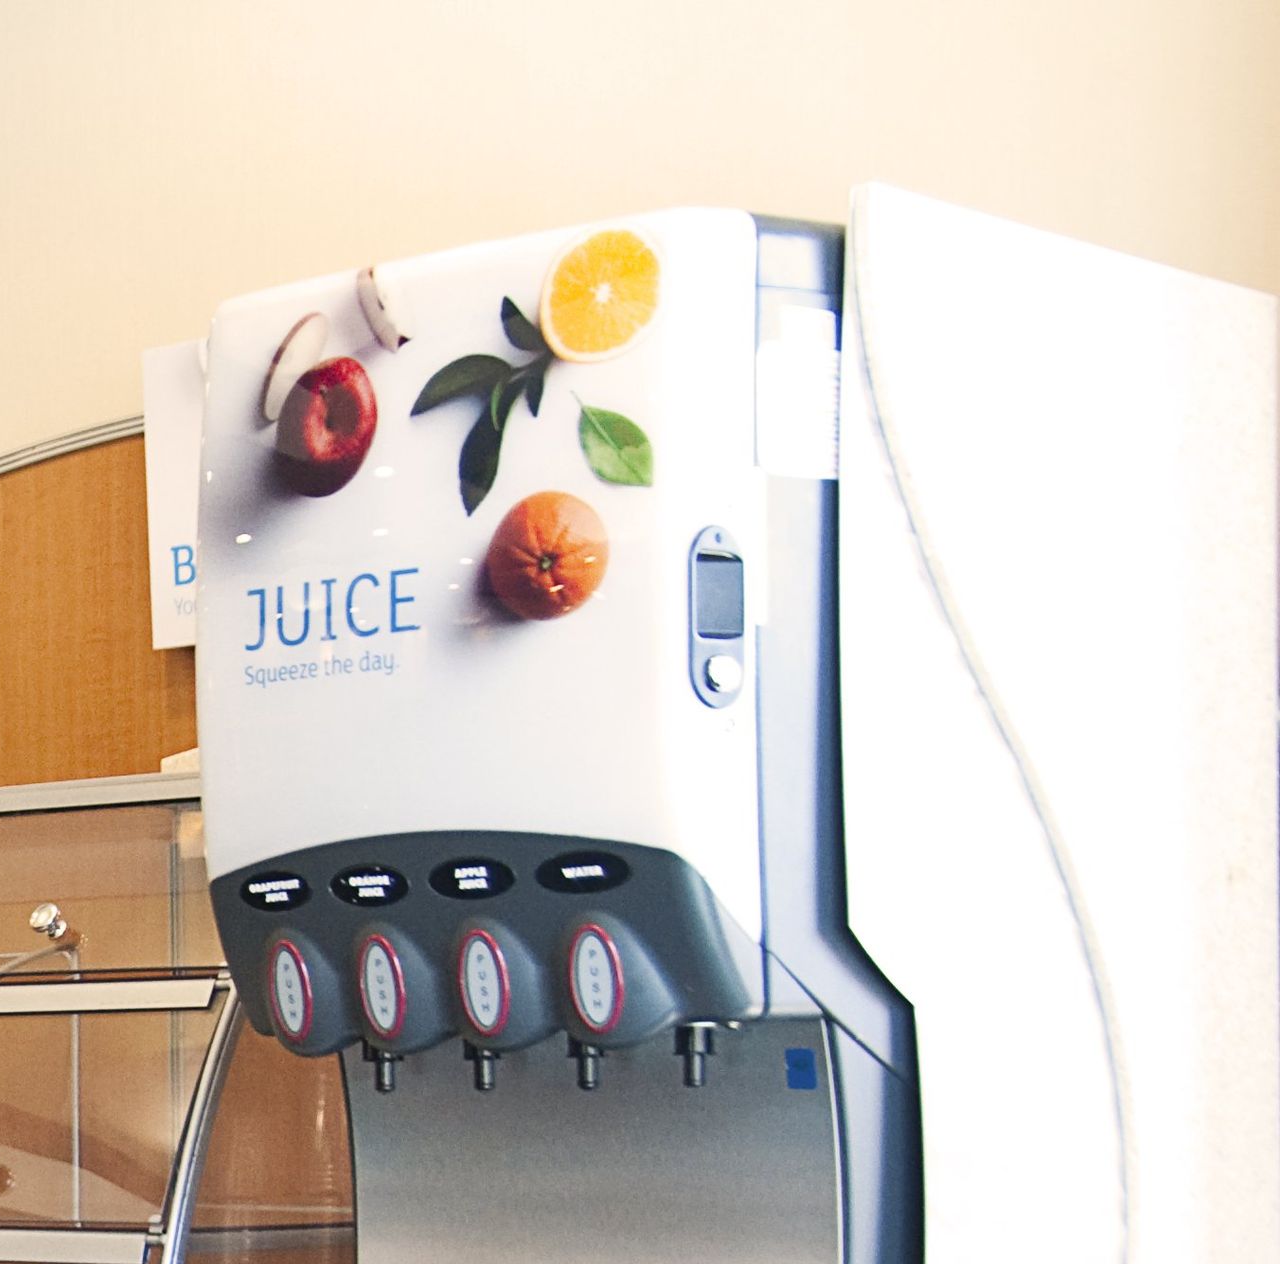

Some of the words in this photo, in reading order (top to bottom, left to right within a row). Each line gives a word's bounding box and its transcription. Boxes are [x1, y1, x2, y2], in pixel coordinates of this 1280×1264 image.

[244, 567, 422, 652] JUICE
[244, 660, 318, 688] Squeeze
[324, 653, 353, 677] the
[359, 650, 400, 676] day.
[348, 874, 391, 887] ORANGE
[454, 866, 488, 879] APPLE
[561, 864, 605, 879] WATER
[283, 963, 297, 1018] PUSH
[374, 957, 389, 1014] PUSH
[476, 953, 490, 1013] PUSH
[588, 949, 602, 1009] PUSH
